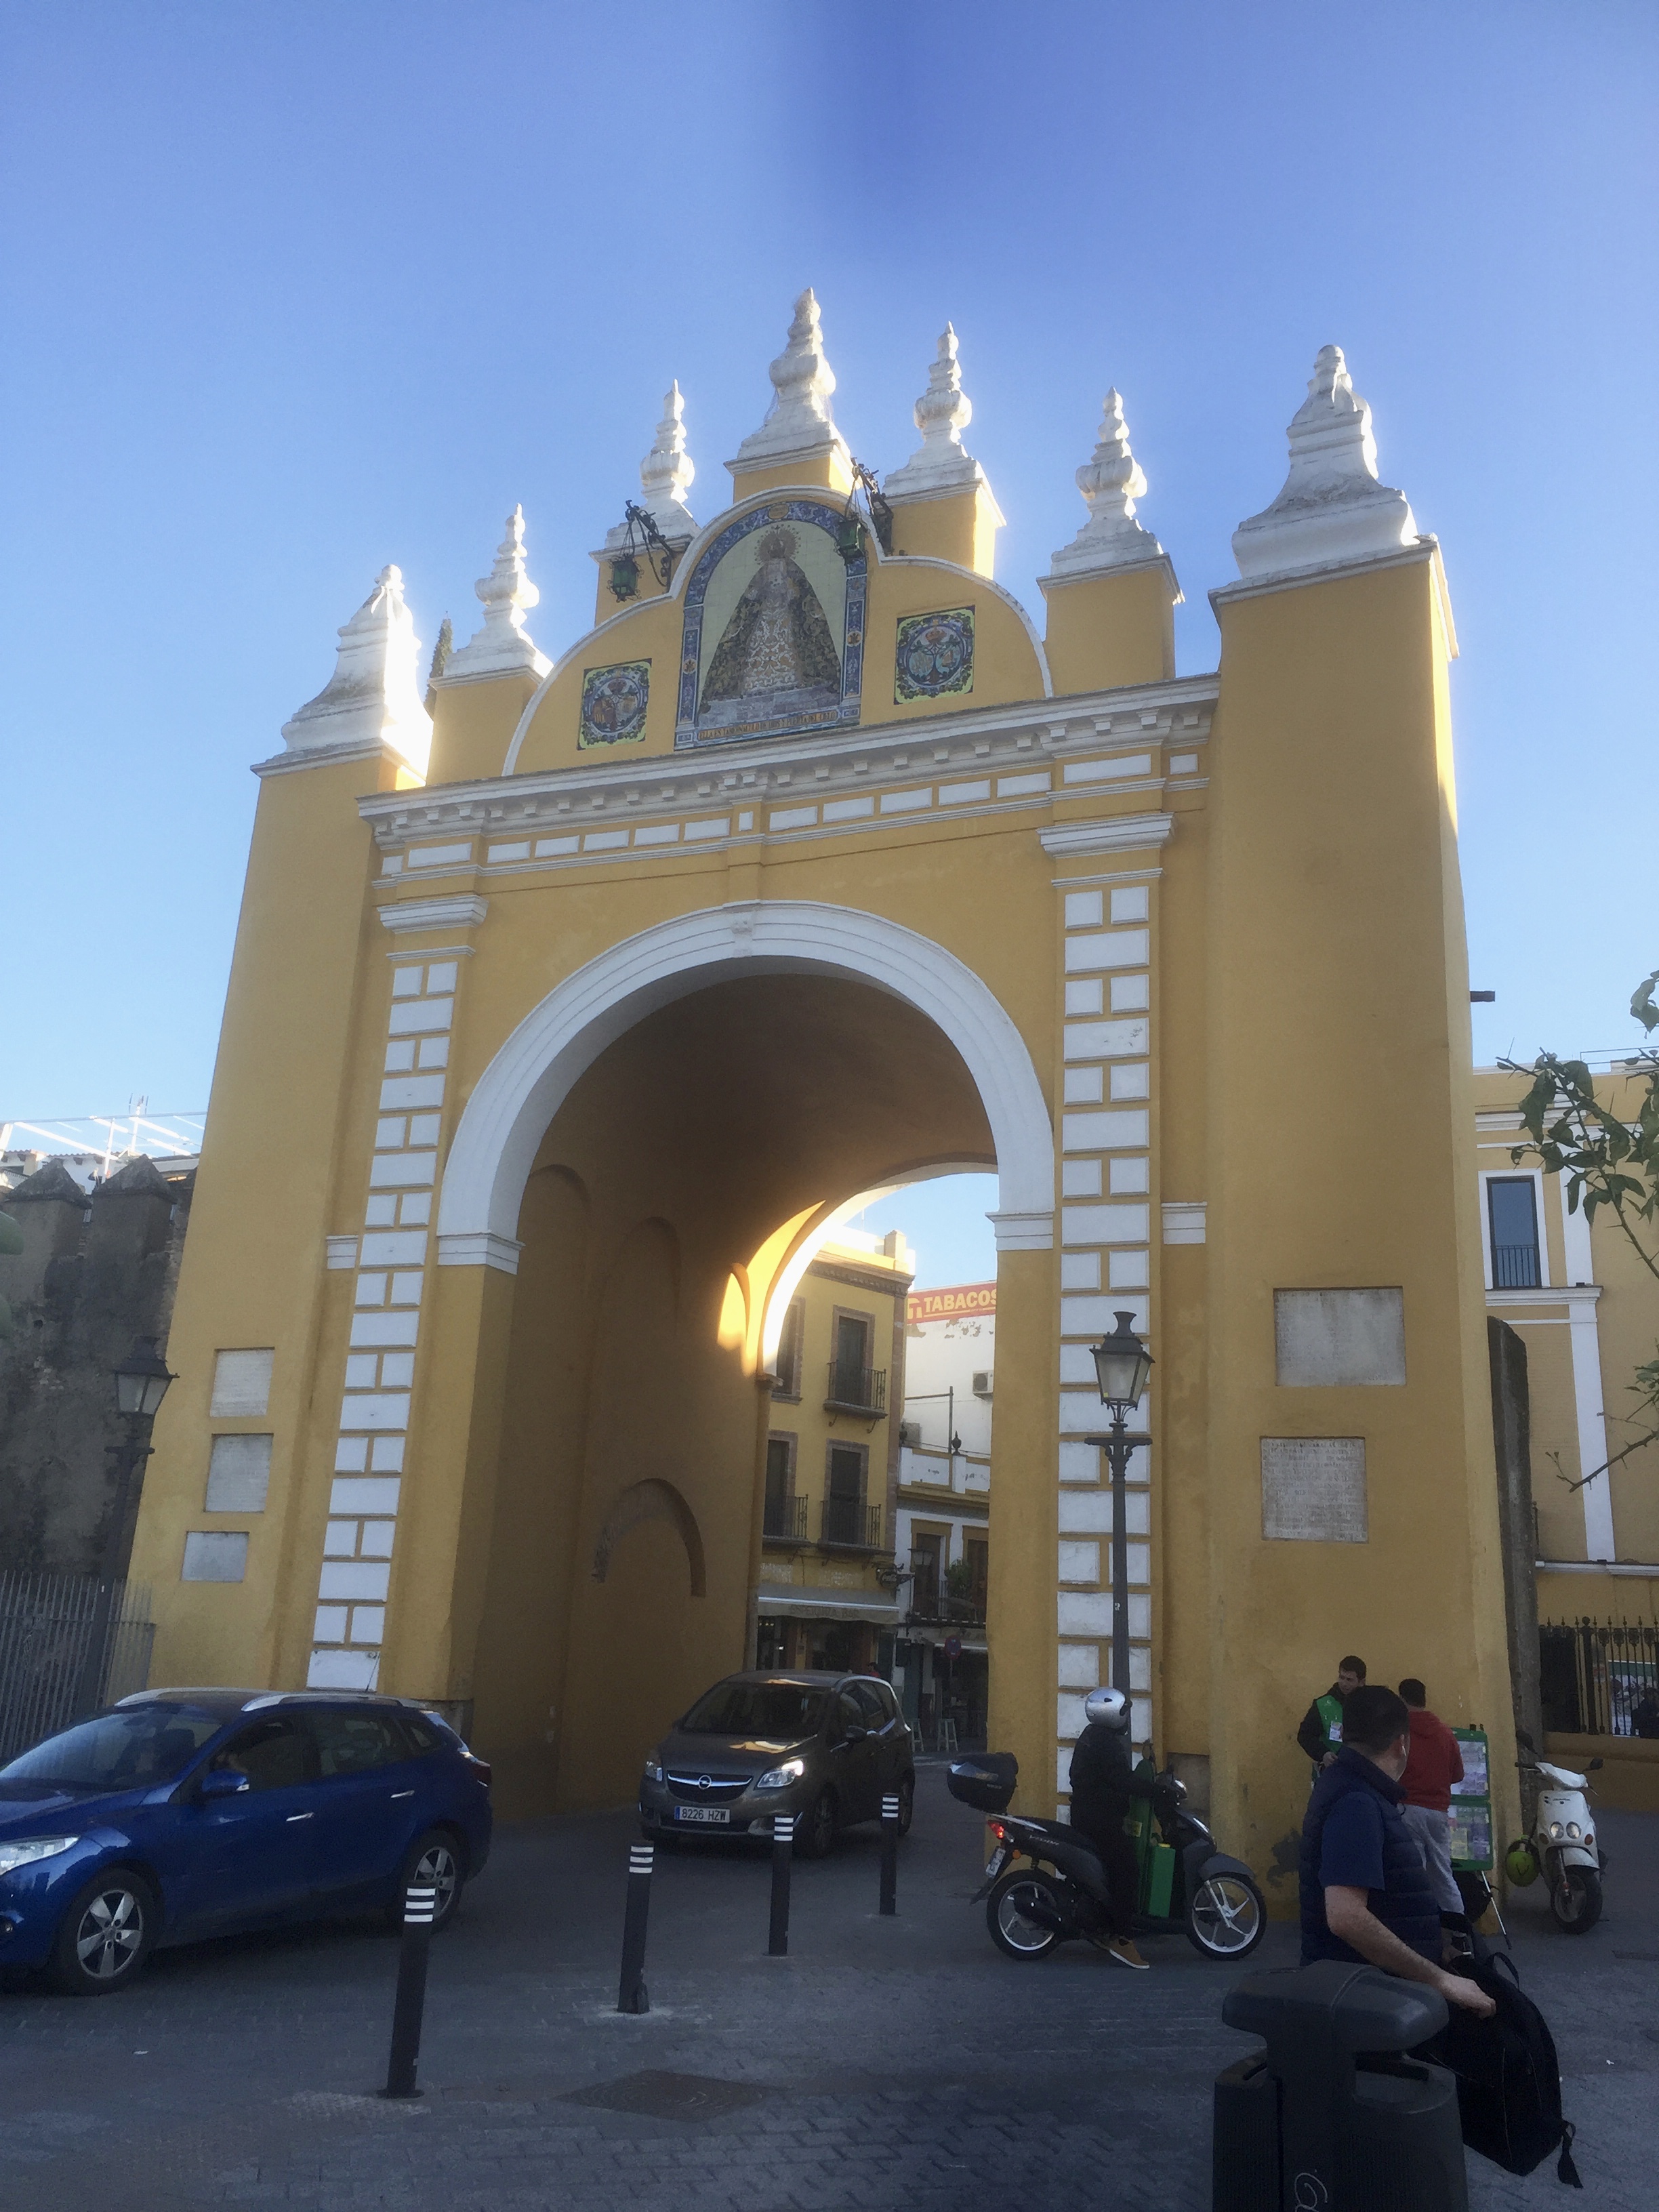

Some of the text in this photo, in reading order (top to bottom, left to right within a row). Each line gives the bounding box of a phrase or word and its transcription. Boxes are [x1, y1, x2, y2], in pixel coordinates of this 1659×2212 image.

[924, 1288, 997, 1313] TABACOS
[682, 1808, 726, 1821] 8226 HZW
